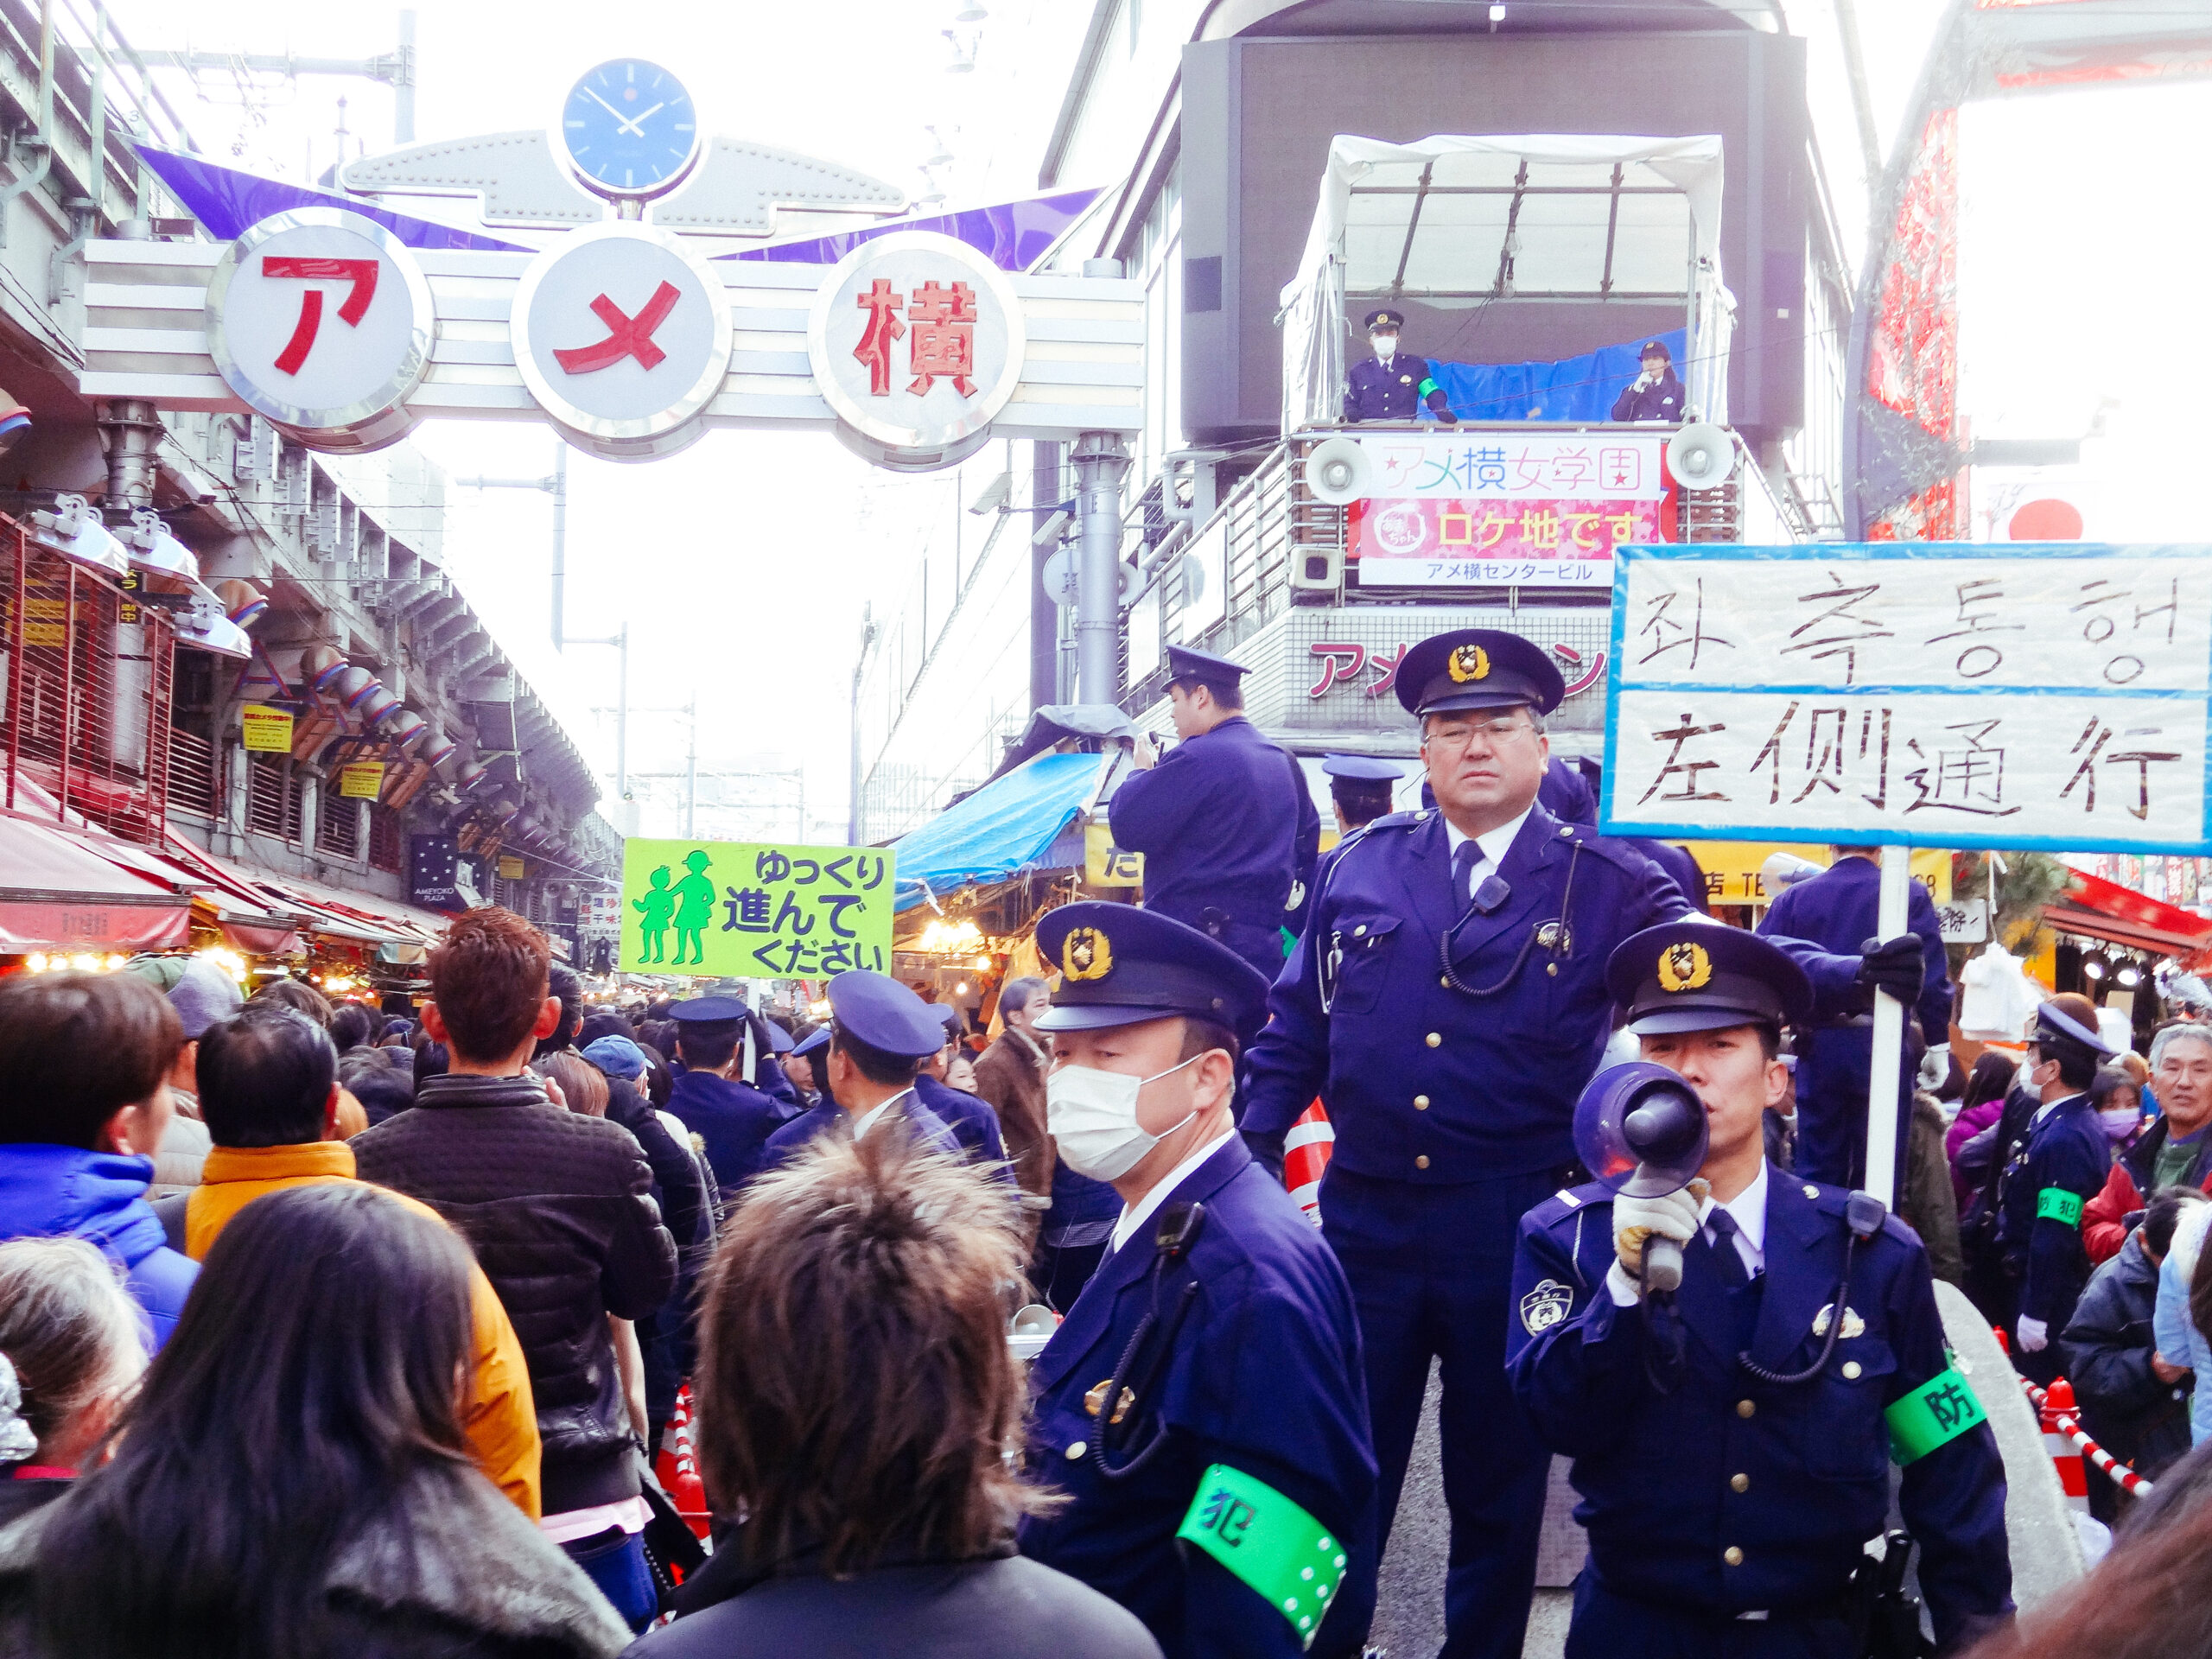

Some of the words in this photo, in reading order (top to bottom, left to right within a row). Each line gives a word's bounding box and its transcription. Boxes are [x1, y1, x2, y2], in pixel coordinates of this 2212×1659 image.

[262, 256, 978, 398] アメ横
[1382, 446, 1641, 492] アメ横女学園
[1439, 510, 1642, 549] ロケ地です
[1427, 563, 1592, 582] アメ横センタービル
[1637, 701, 2183, 821] 左侧通行
[756, 850, 885, 889] ゆっくり
[721, 887, 867, 938] 進んで
[753, 938, 881, 974] ください
[1923, 1382, 1974, 1433] 防
[1201, 1487, 1255, 1548] 犯
